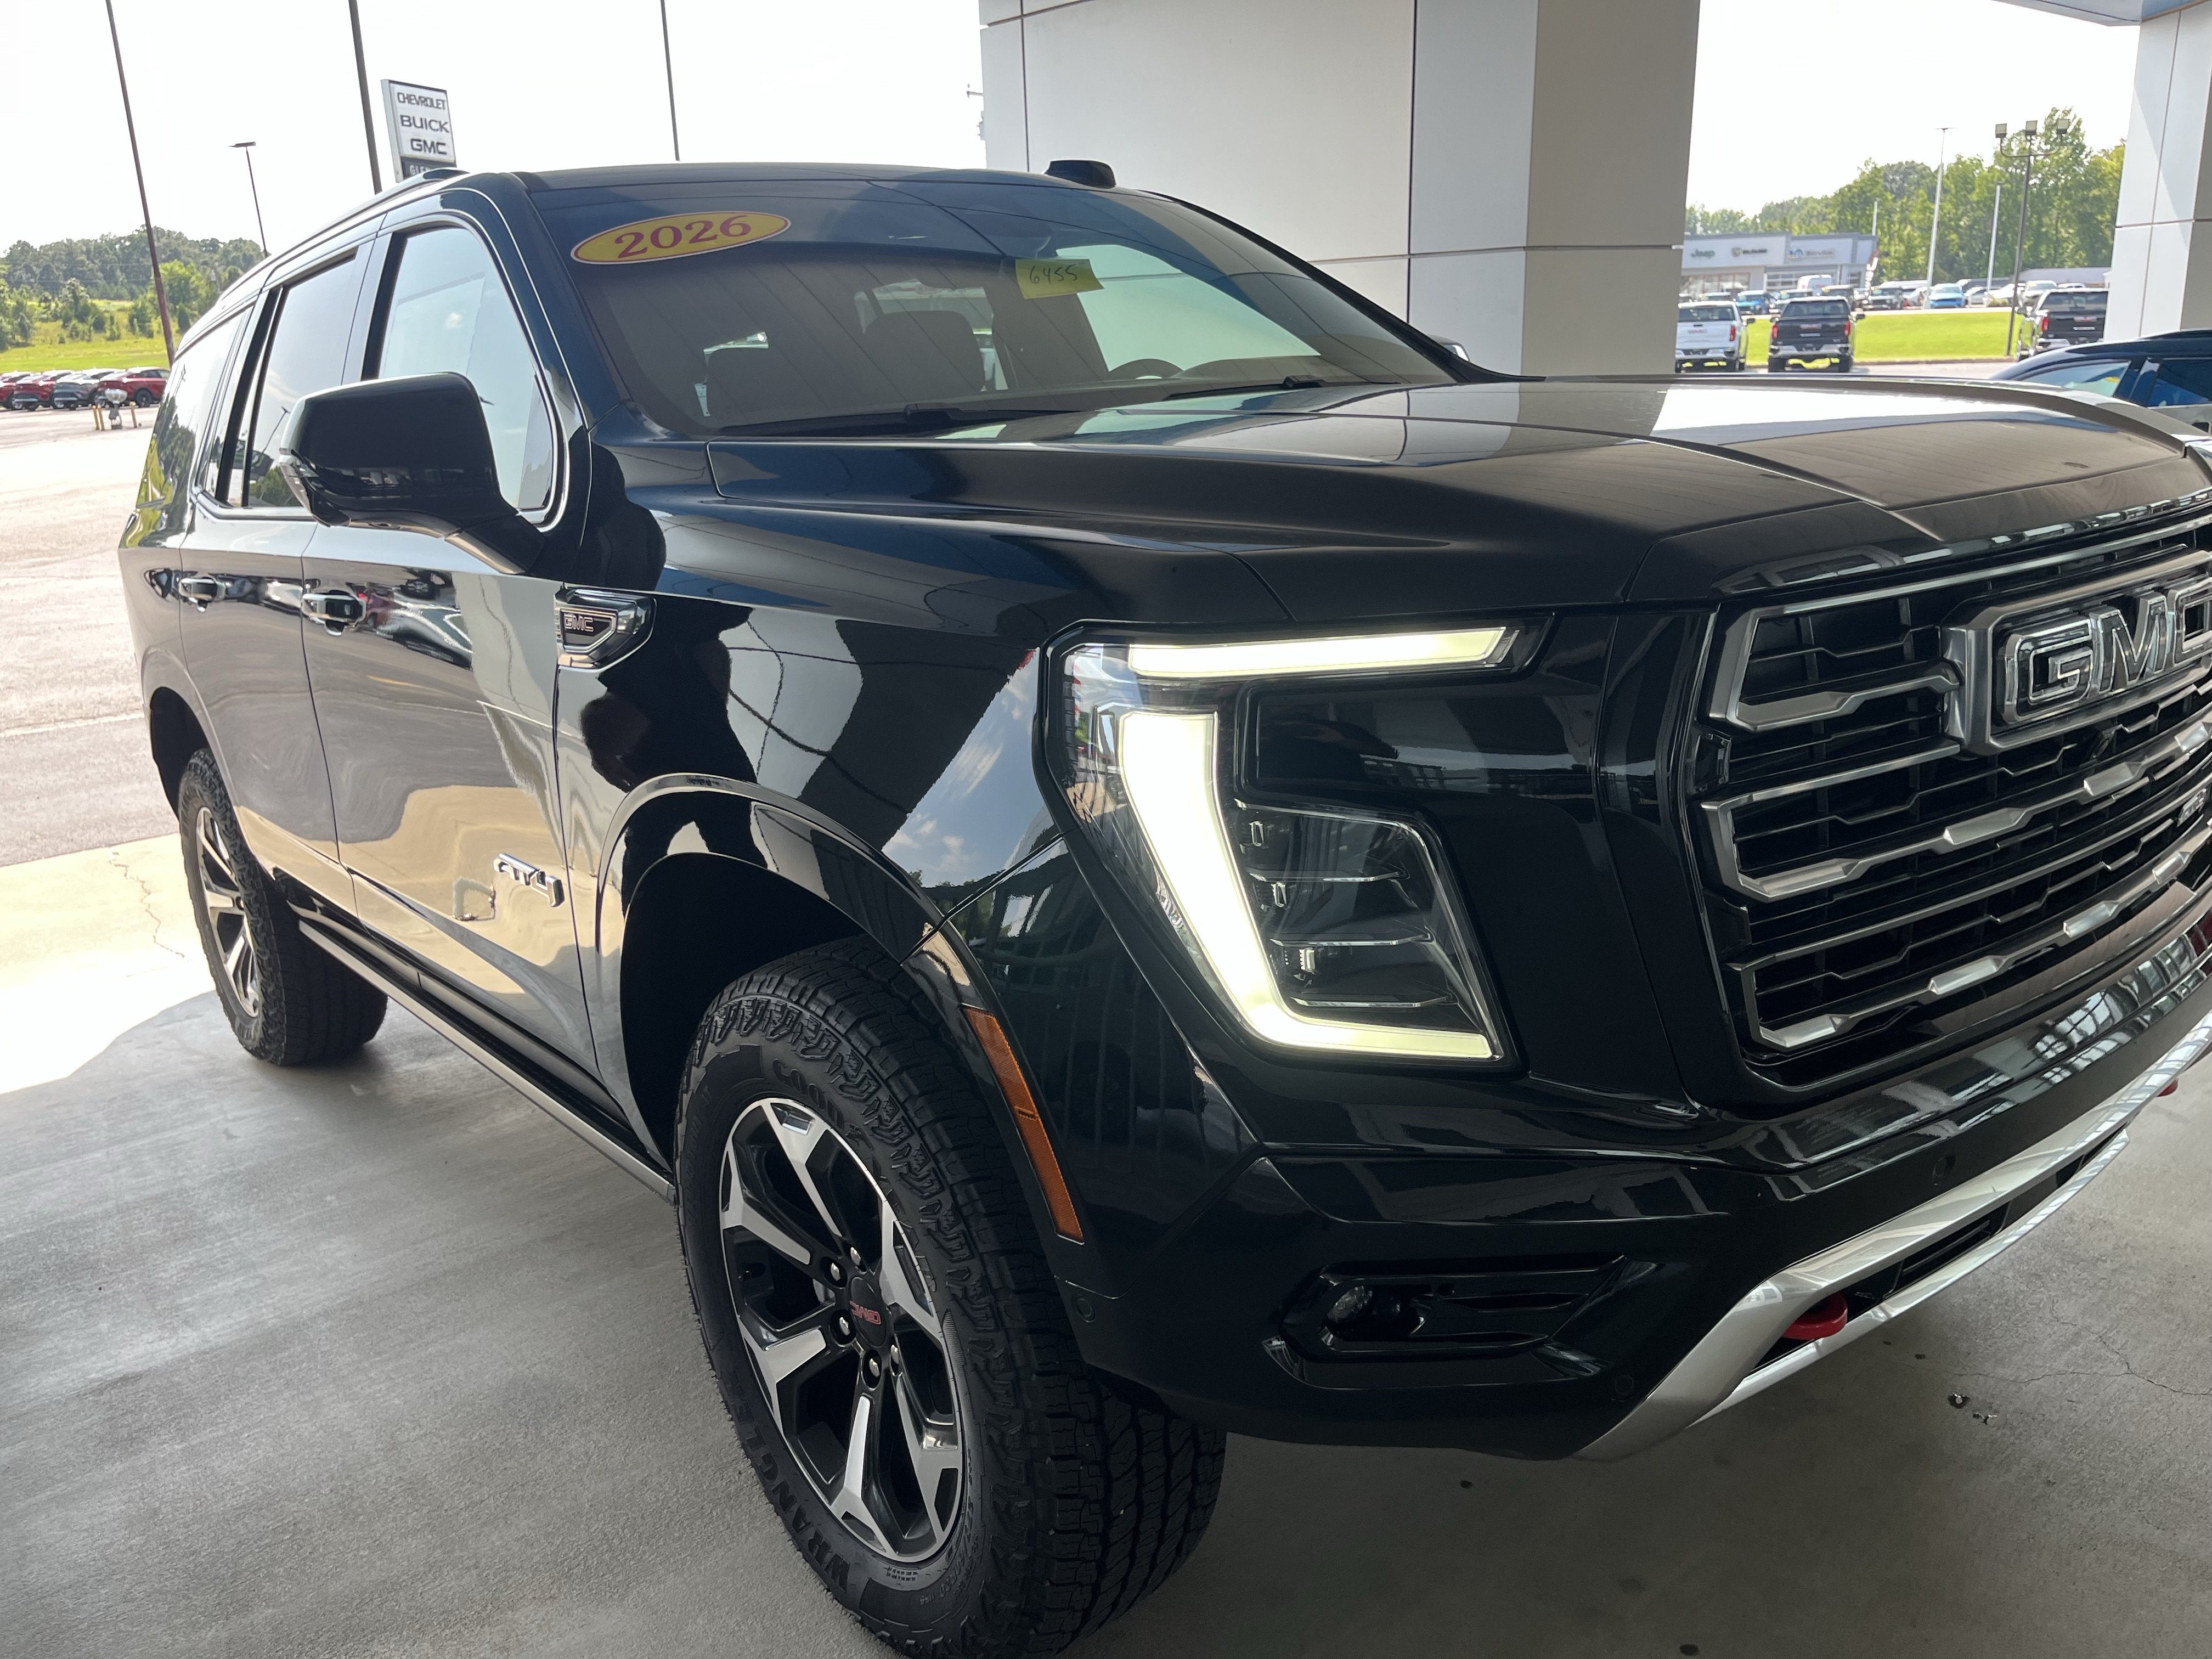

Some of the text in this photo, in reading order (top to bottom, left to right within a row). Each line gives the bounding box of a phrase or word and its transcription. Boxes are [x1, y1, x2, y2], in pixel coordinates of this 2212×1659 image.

[397, 92, 446, 110] CHEVROLET
[399, 114, 450, 133] BUICK
[410, 138, 448, 155] GMC
[614, 215, 752, 258] 2026
[1029, 263, 1078, 285] 6455
[563, 613, 594, 633] GMC
[849, 1300, 882, 1325] GMC
